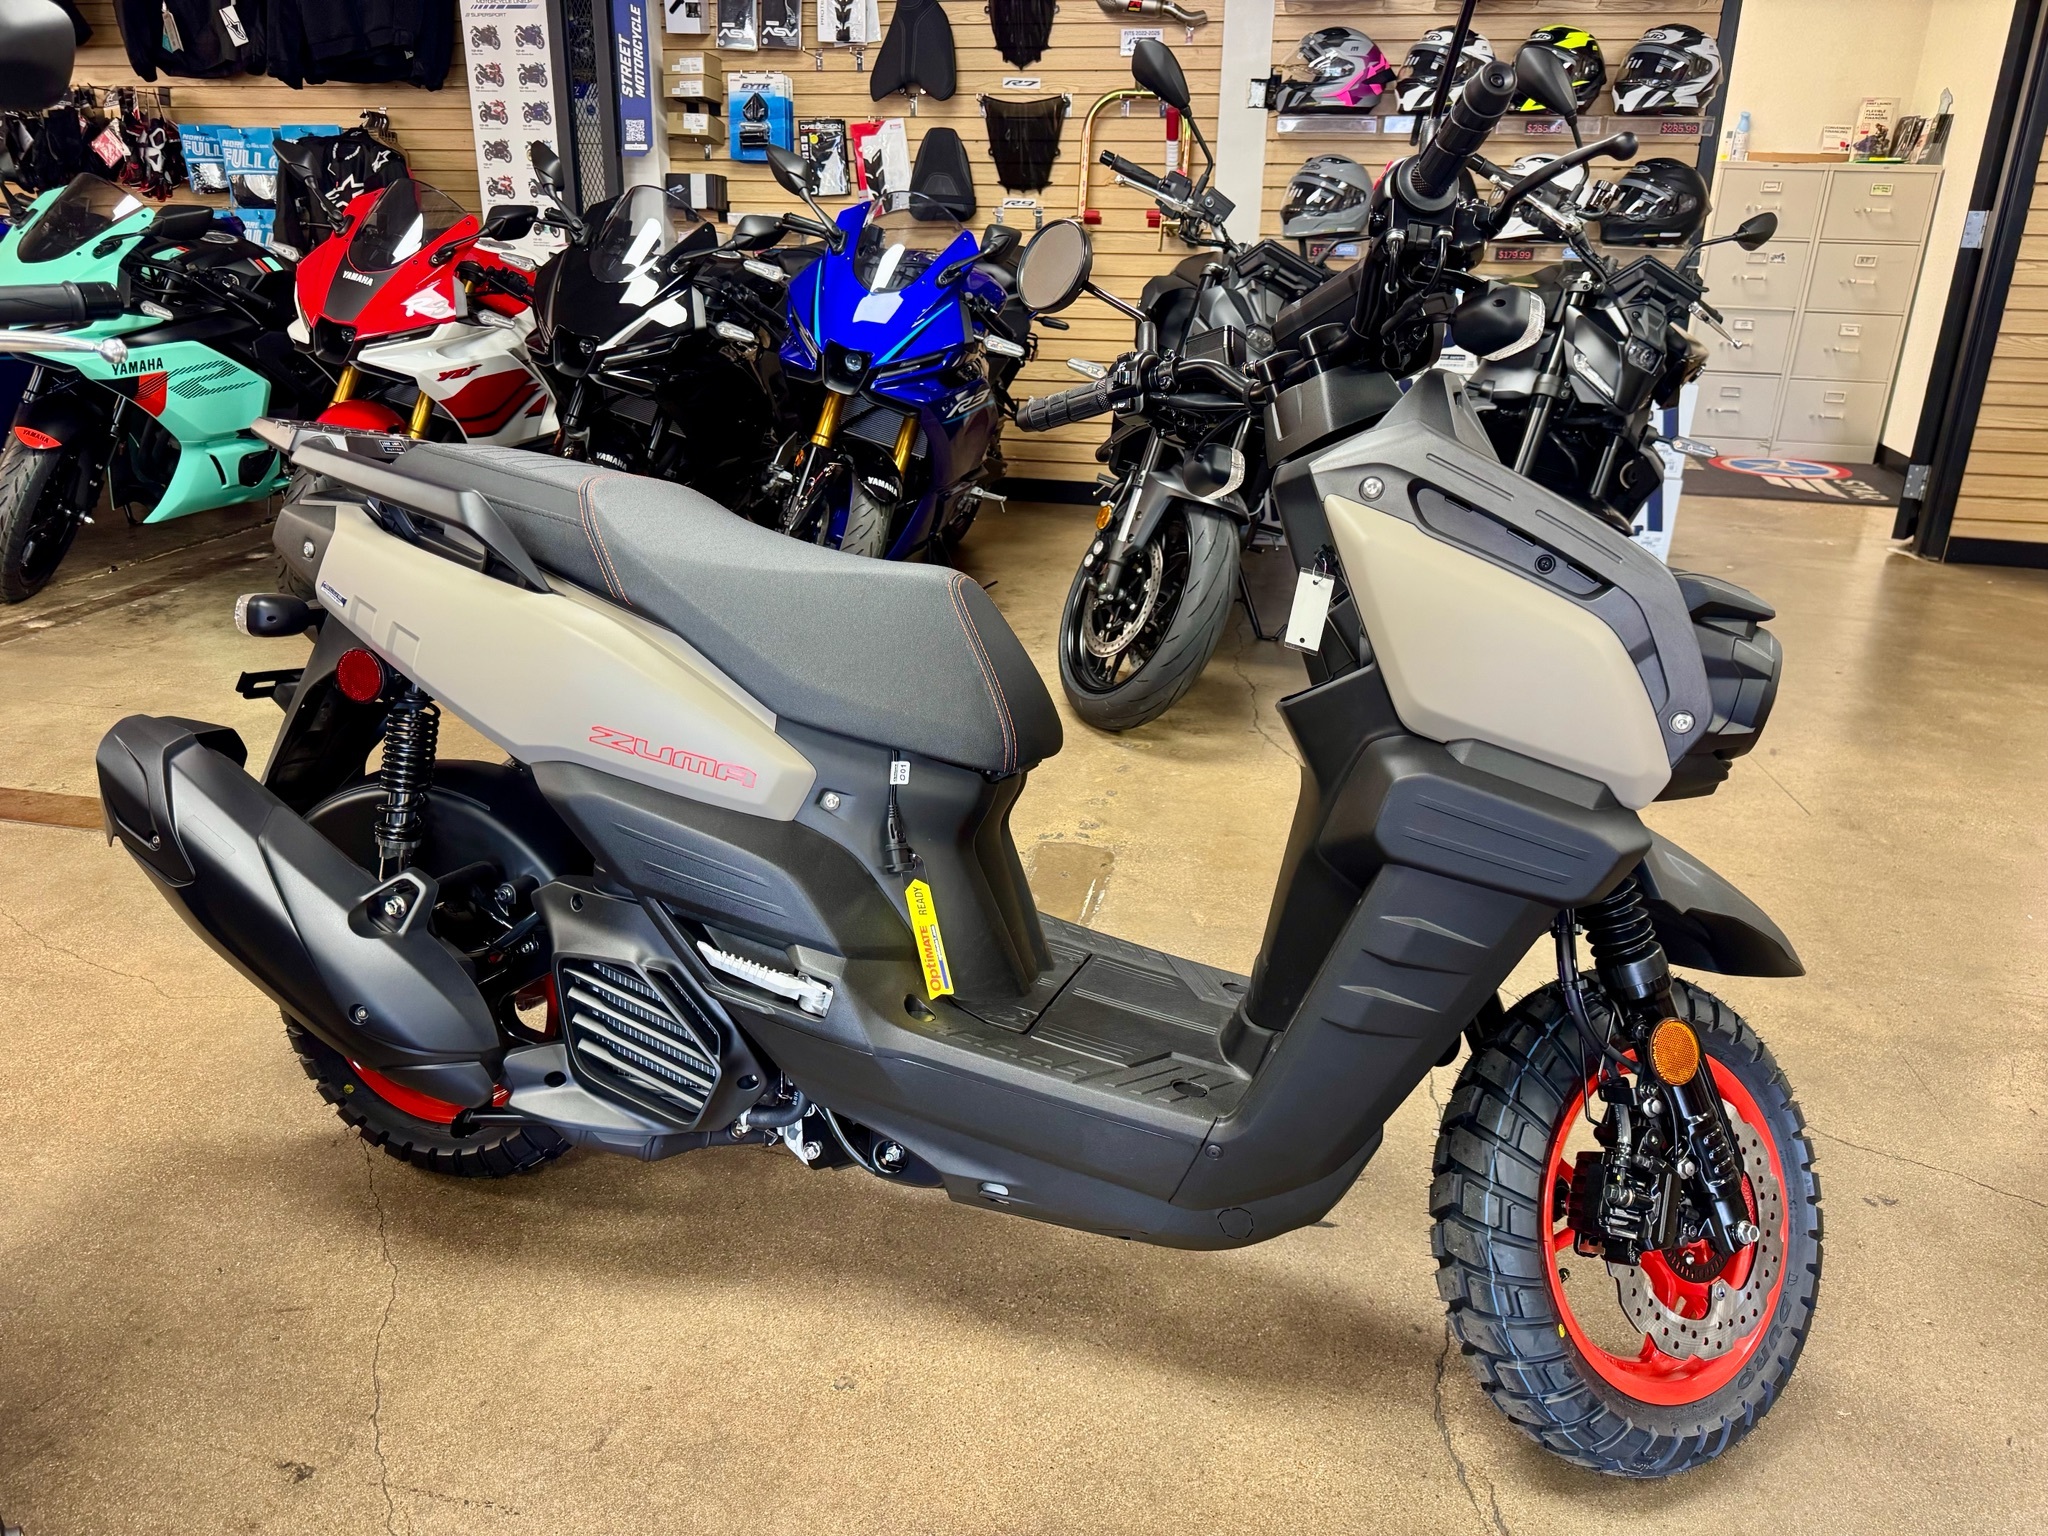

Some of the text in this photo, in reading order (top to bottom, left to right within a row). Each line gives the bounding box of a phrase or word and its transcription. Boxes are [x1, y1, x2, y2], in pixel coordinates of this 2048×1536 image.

[762, 26, 797, 37] ASV
[630, 4, 645, 98] MOTORCYCLE
[618, 33, 633, 98] STREET
[1662, 124, 1698, 133] $285.99
[223, 147, 266, 169] FULL
[1498, 250, 1531, 259] $179.99
[343, 271, 374, 287] YAMAHA
[112, 357, 164, 376] YAMAHA
[22, 430, 49, 444] YAMAHA
[596, 452, 627, 471] YAMAHA
[867, 476, 898, 497] YAMAHA
[589, 726, 757, 788] ZUMA
[914, 886, 928, 916] READY
[918, 925, 941, 992] OptiMATE
